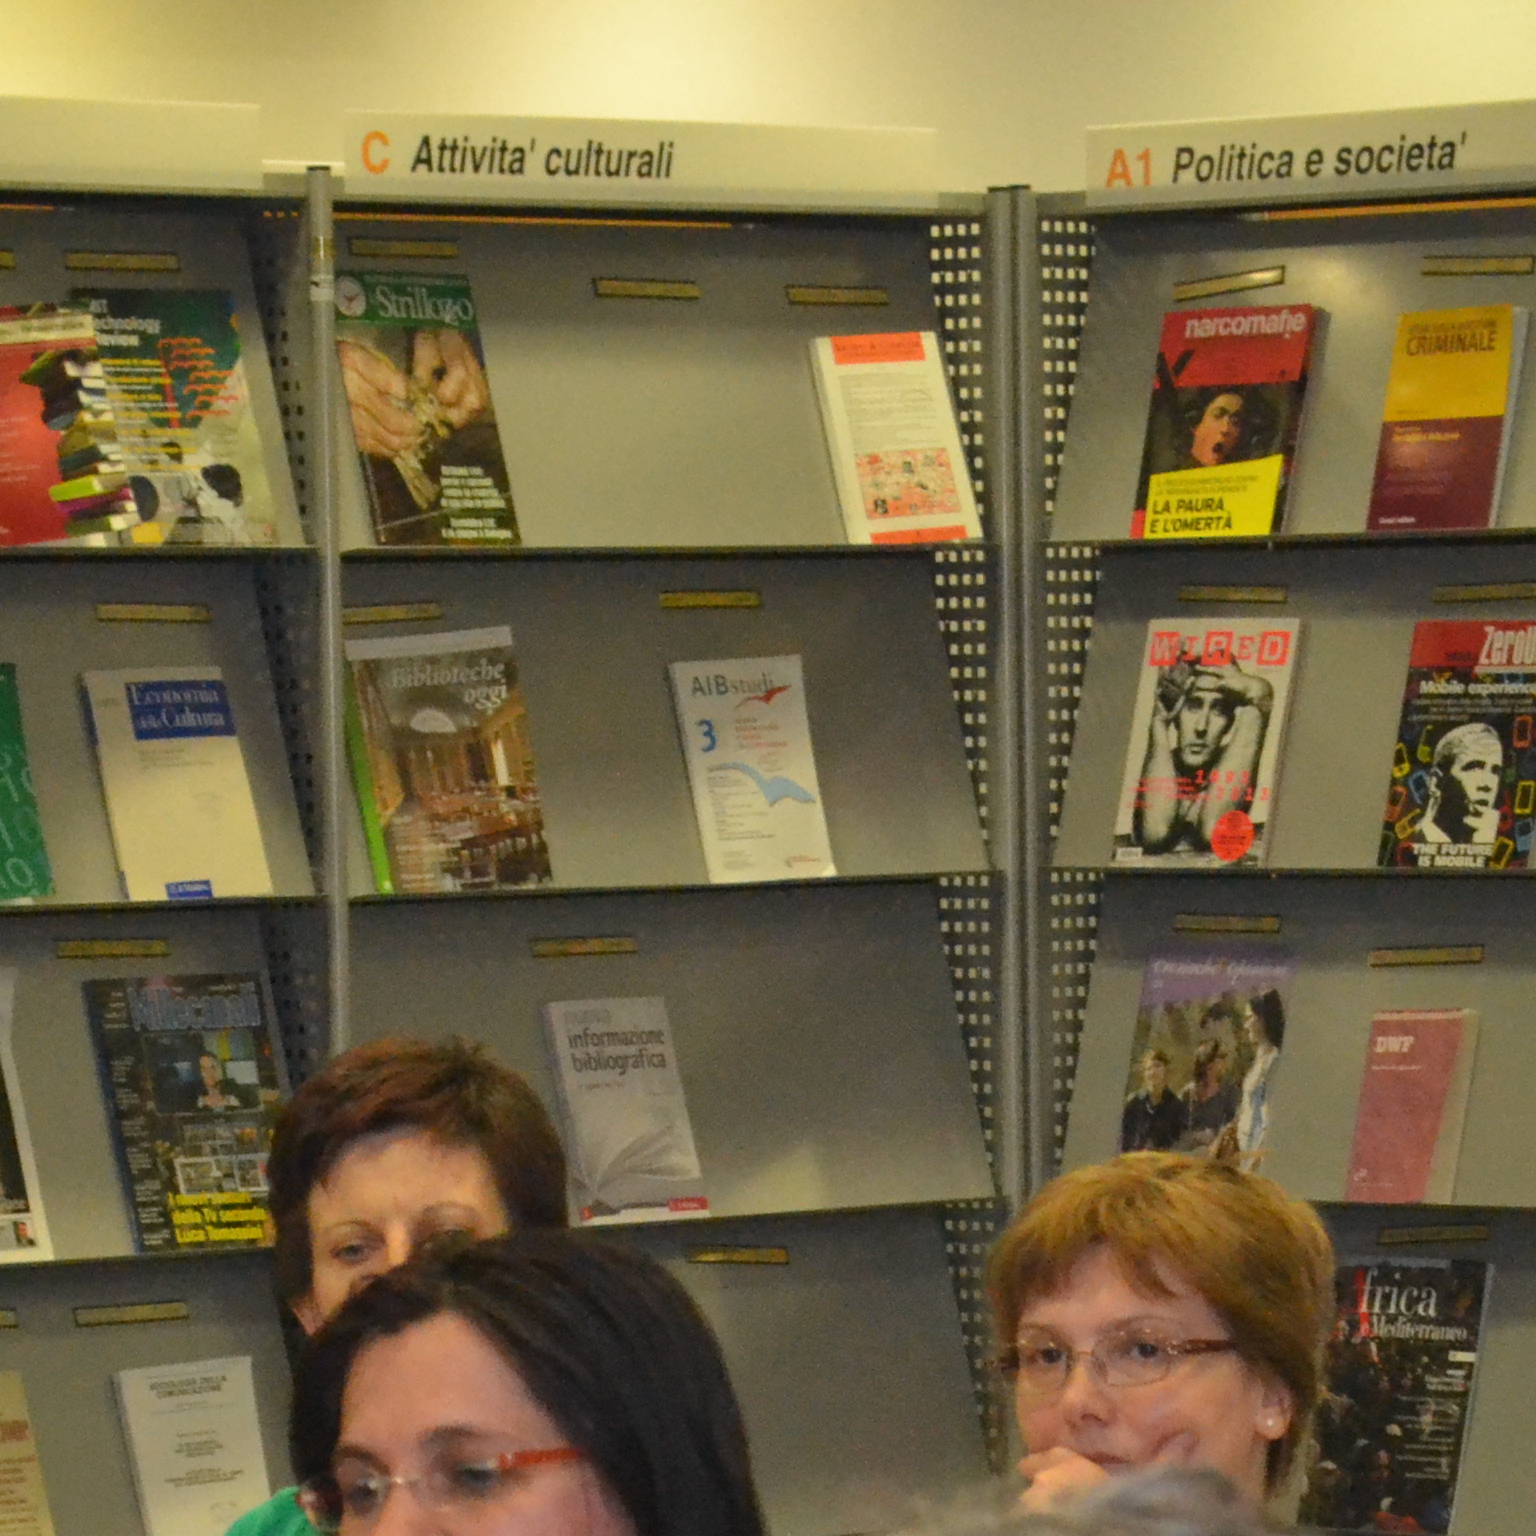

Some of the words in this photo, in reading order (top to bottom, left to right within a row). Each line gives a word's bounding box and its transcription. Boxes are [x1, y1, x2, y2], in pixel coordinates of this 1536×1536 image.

[361, 130, 390, 175] C
[411, 135, 535, 176] Attivita'
[544, 139, 675, 179] culturali
[1105, 147, 1153, 188] A1
[1171, 143, 1294, 185] Politica
[1304, 149, 1325, 177] e
[1333, 131, 1468, 177] societa'
[1149, 630, 1292, 666] WIRED
[697, 719, 718, 753] 3
[567, 1026, 665, 1049] informazione
[570, 1047, 667, 1076] bibliografica
